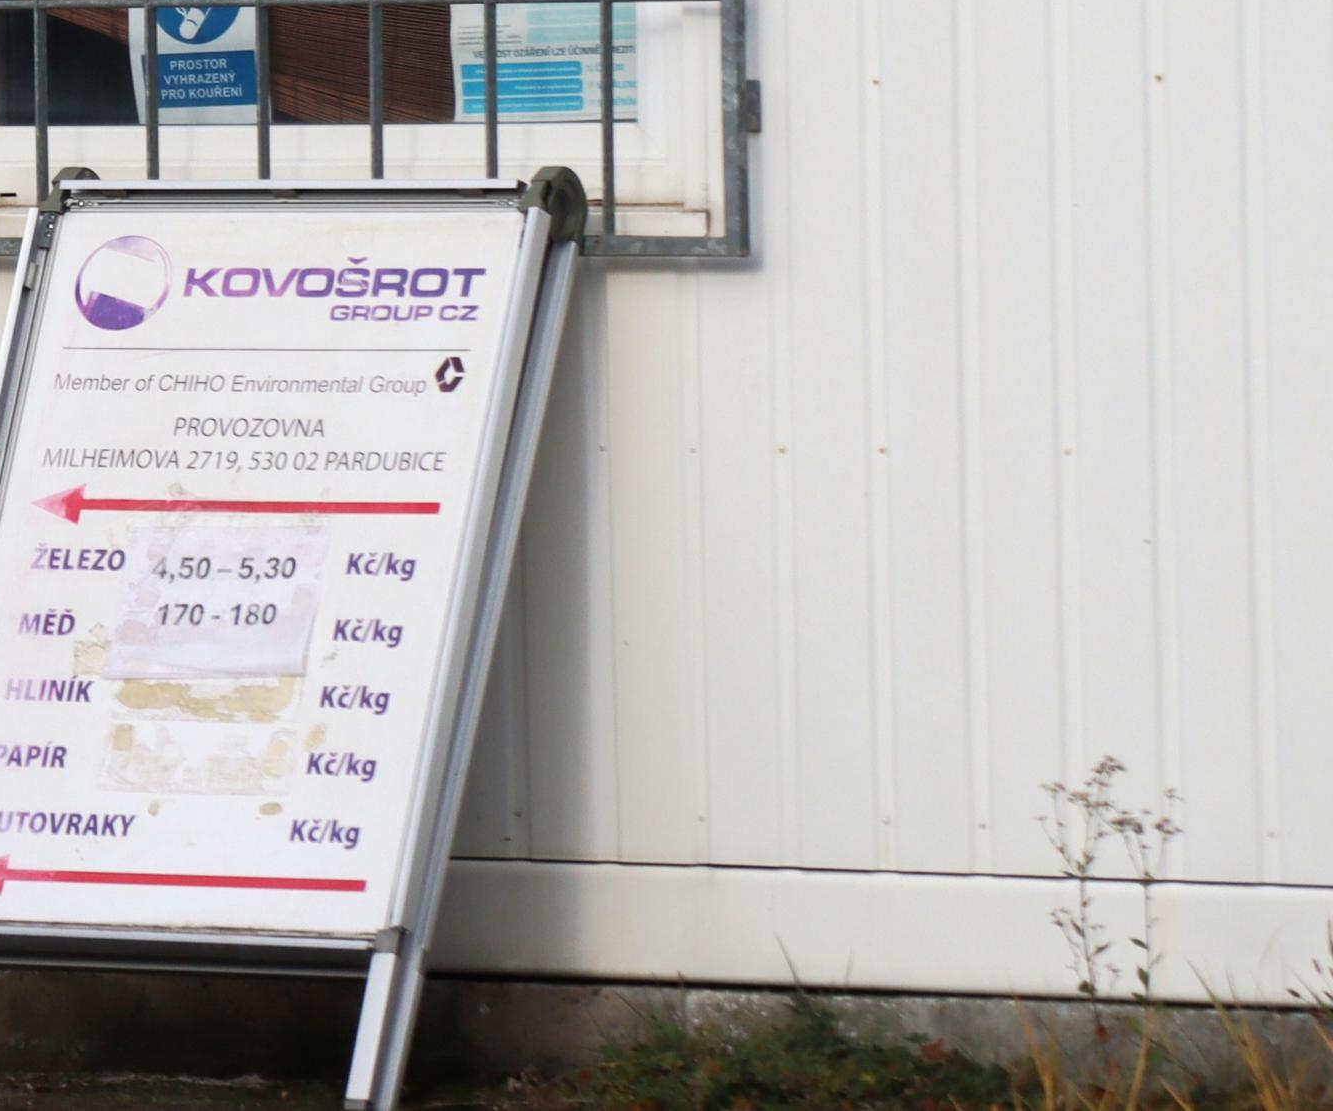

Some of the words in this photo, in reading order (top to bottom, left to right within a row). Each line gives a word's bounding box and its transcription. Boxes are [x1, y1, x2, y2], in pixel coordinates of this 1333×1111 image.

[170, 58, 228, 70] PROSTOR
[161, 89, 186, 100] PRO
[189, 83, 244, 99] KOUŘENÍ
[183, 256, 487, 298] KOVOŠROT
[329, 304, 433, 322] GROUP
[438, 304, 480, 322] CZ
[53, 373, 129, 392] Member
[135, 373, 156, 393] of
[158, 373, 226, 393] CHIHO
[230, 374, 363, 394] Environmental
[369, 375, 427, 397] Group
[173, 417, 325, 439] PROVOZOVNA
[42, 448, 180, 470] MILHEIMOVA
[185, 449, 242, 473] 2719,
[248, 450, 289, 472] 530
[292, 451, 319, 472] 02
[323, 451, 447, 472] PARDUBICE
[30, 542, 126, 572] ŽELEZO
[151, 556, 211, 584] 4,50
[238, 556, 297, 583] 5,30
[345, 552, 417, 582] Kč/kg
[18, 609, 76, 636] MĚĎ
[158, 603, 205, 626] 170
[230, 603, 277, 626] 180
[333, 619, 404, 649] Kč/kg
[4, 675, 94, 703] HLINÍK
[319, 686, 391, 716] Kč/kg
[306, 752, 377, 783] Kč/kg
[289, 819, 361, 850] Kč/kg
